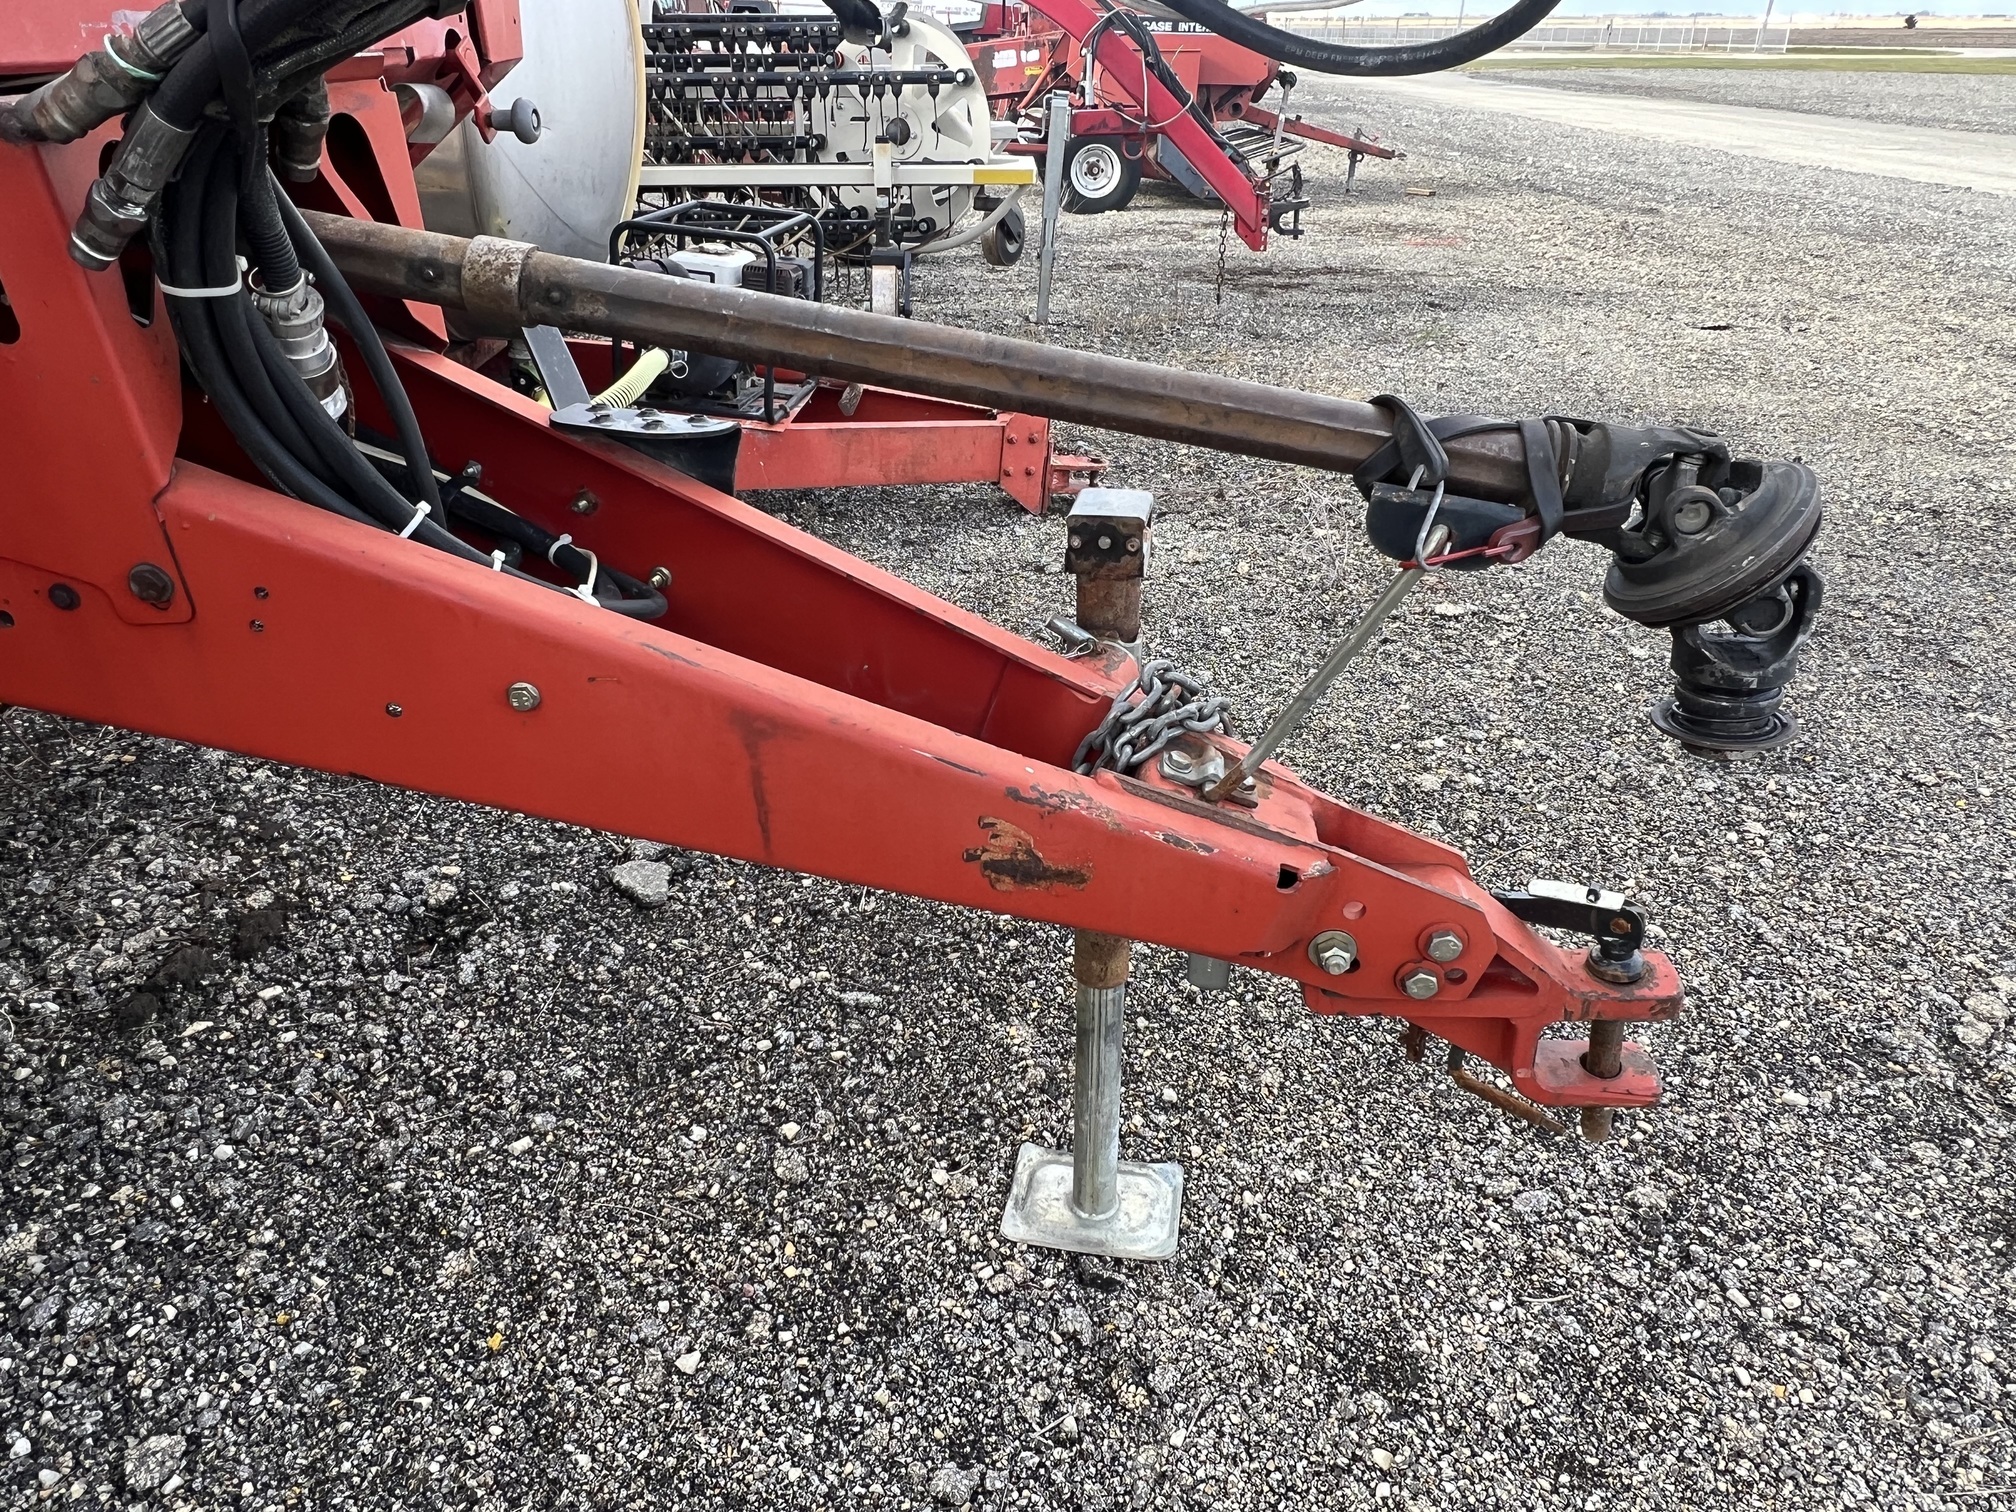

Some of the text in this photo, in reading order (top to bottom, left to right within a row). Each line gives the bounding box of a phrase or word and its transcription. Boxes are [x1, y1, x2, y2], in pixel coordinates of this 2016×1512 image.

[1142, 21, 1211, 32] CASE INTE
[1304, 49, 1329, 60] DEEP
